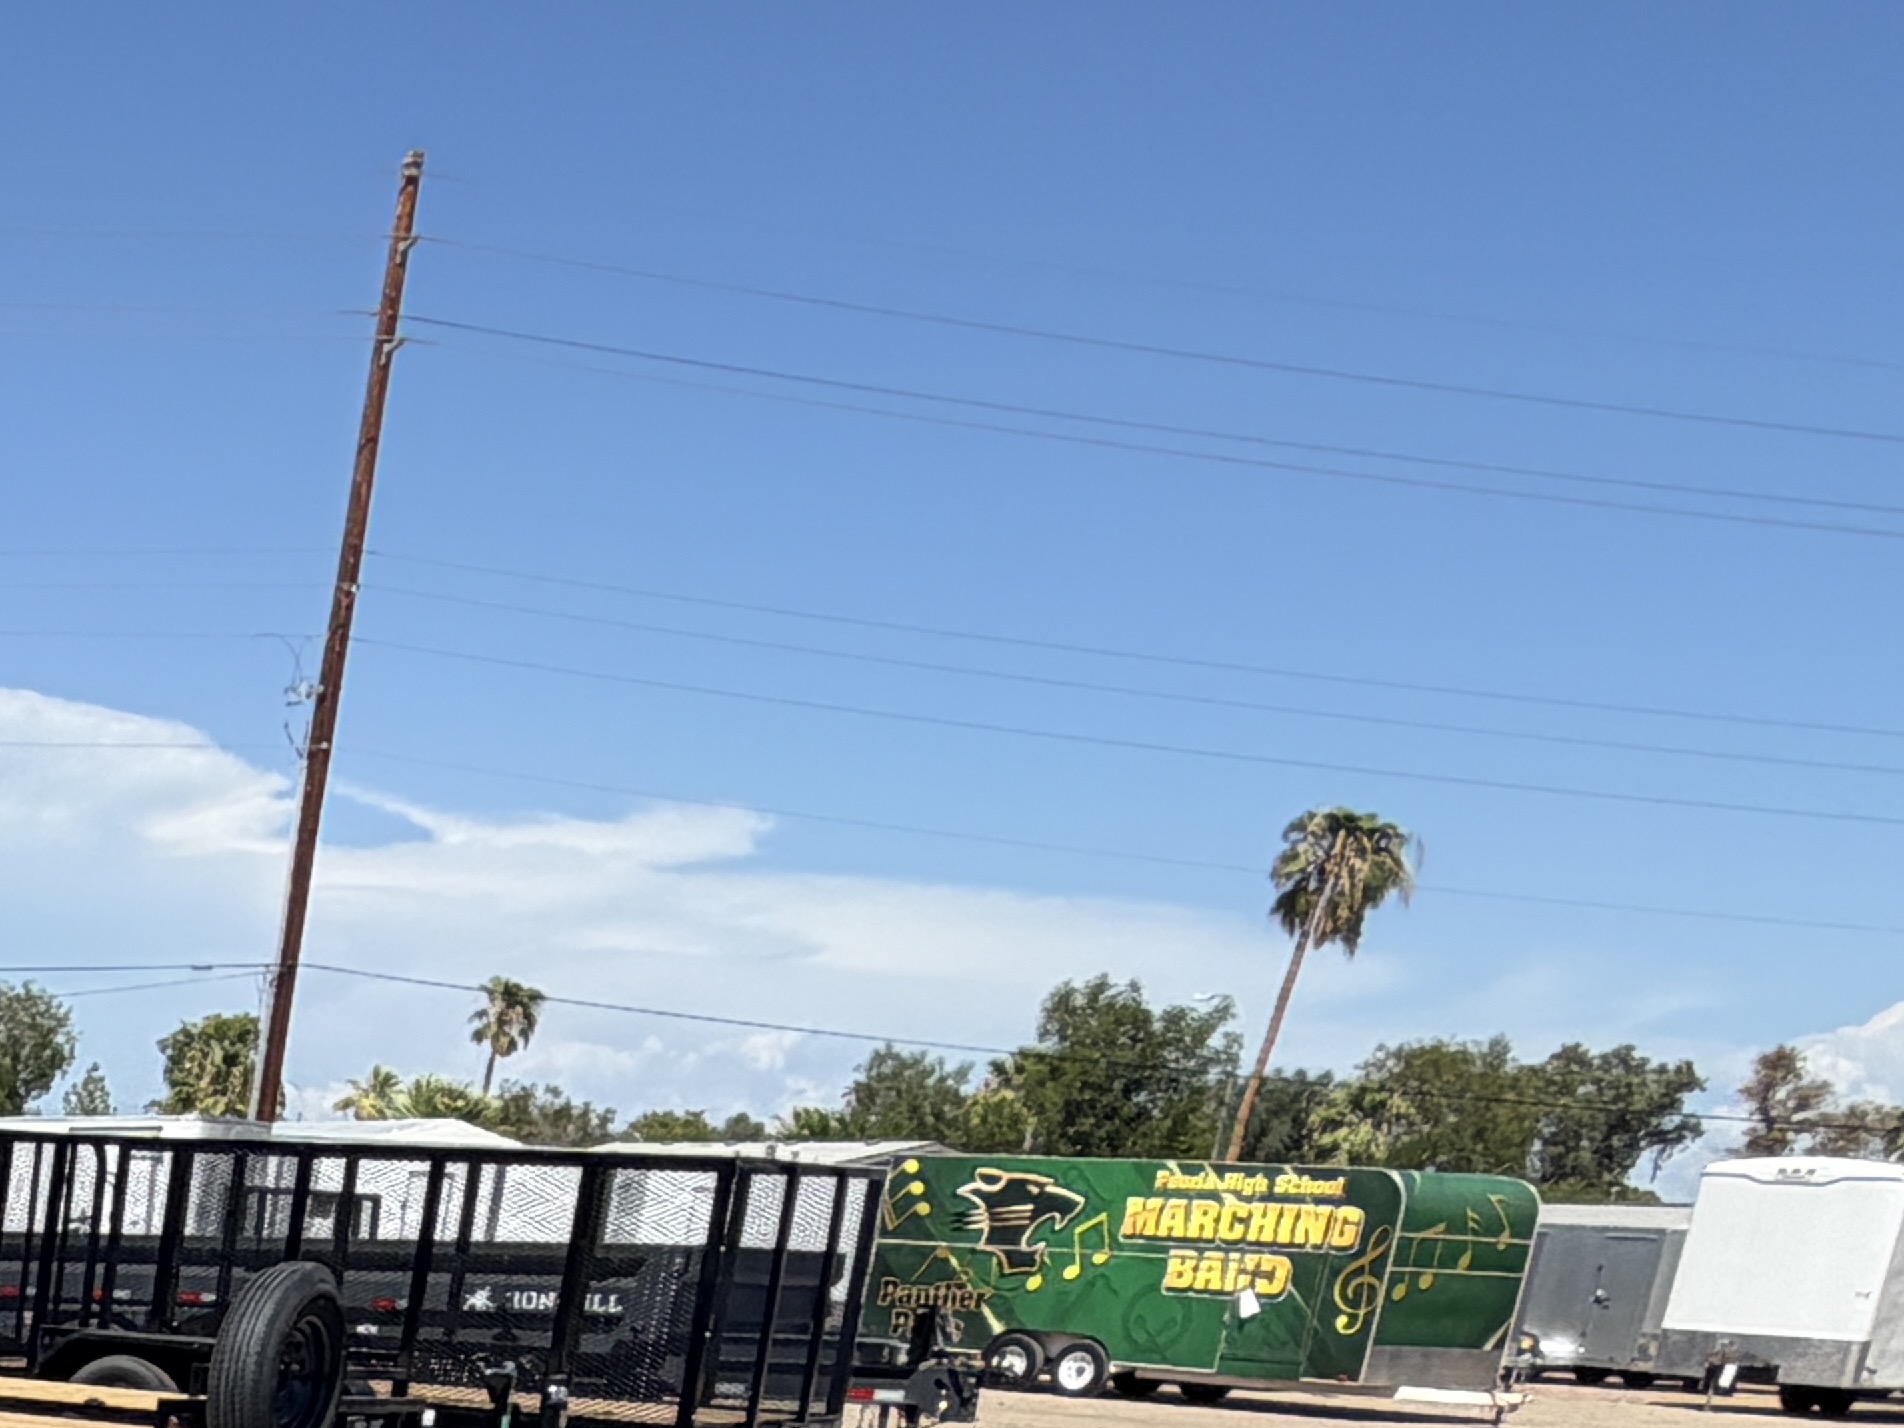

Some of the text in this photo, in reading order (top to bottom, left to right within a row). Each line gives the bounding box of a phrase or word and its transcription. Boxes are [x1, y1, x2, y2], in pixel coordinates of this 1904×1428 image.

[1220, 1172, 1268, 1196] High
[1274, 1174, 1348, 1197] School
[1120, 1195, 1366, 1250] MARCHING
